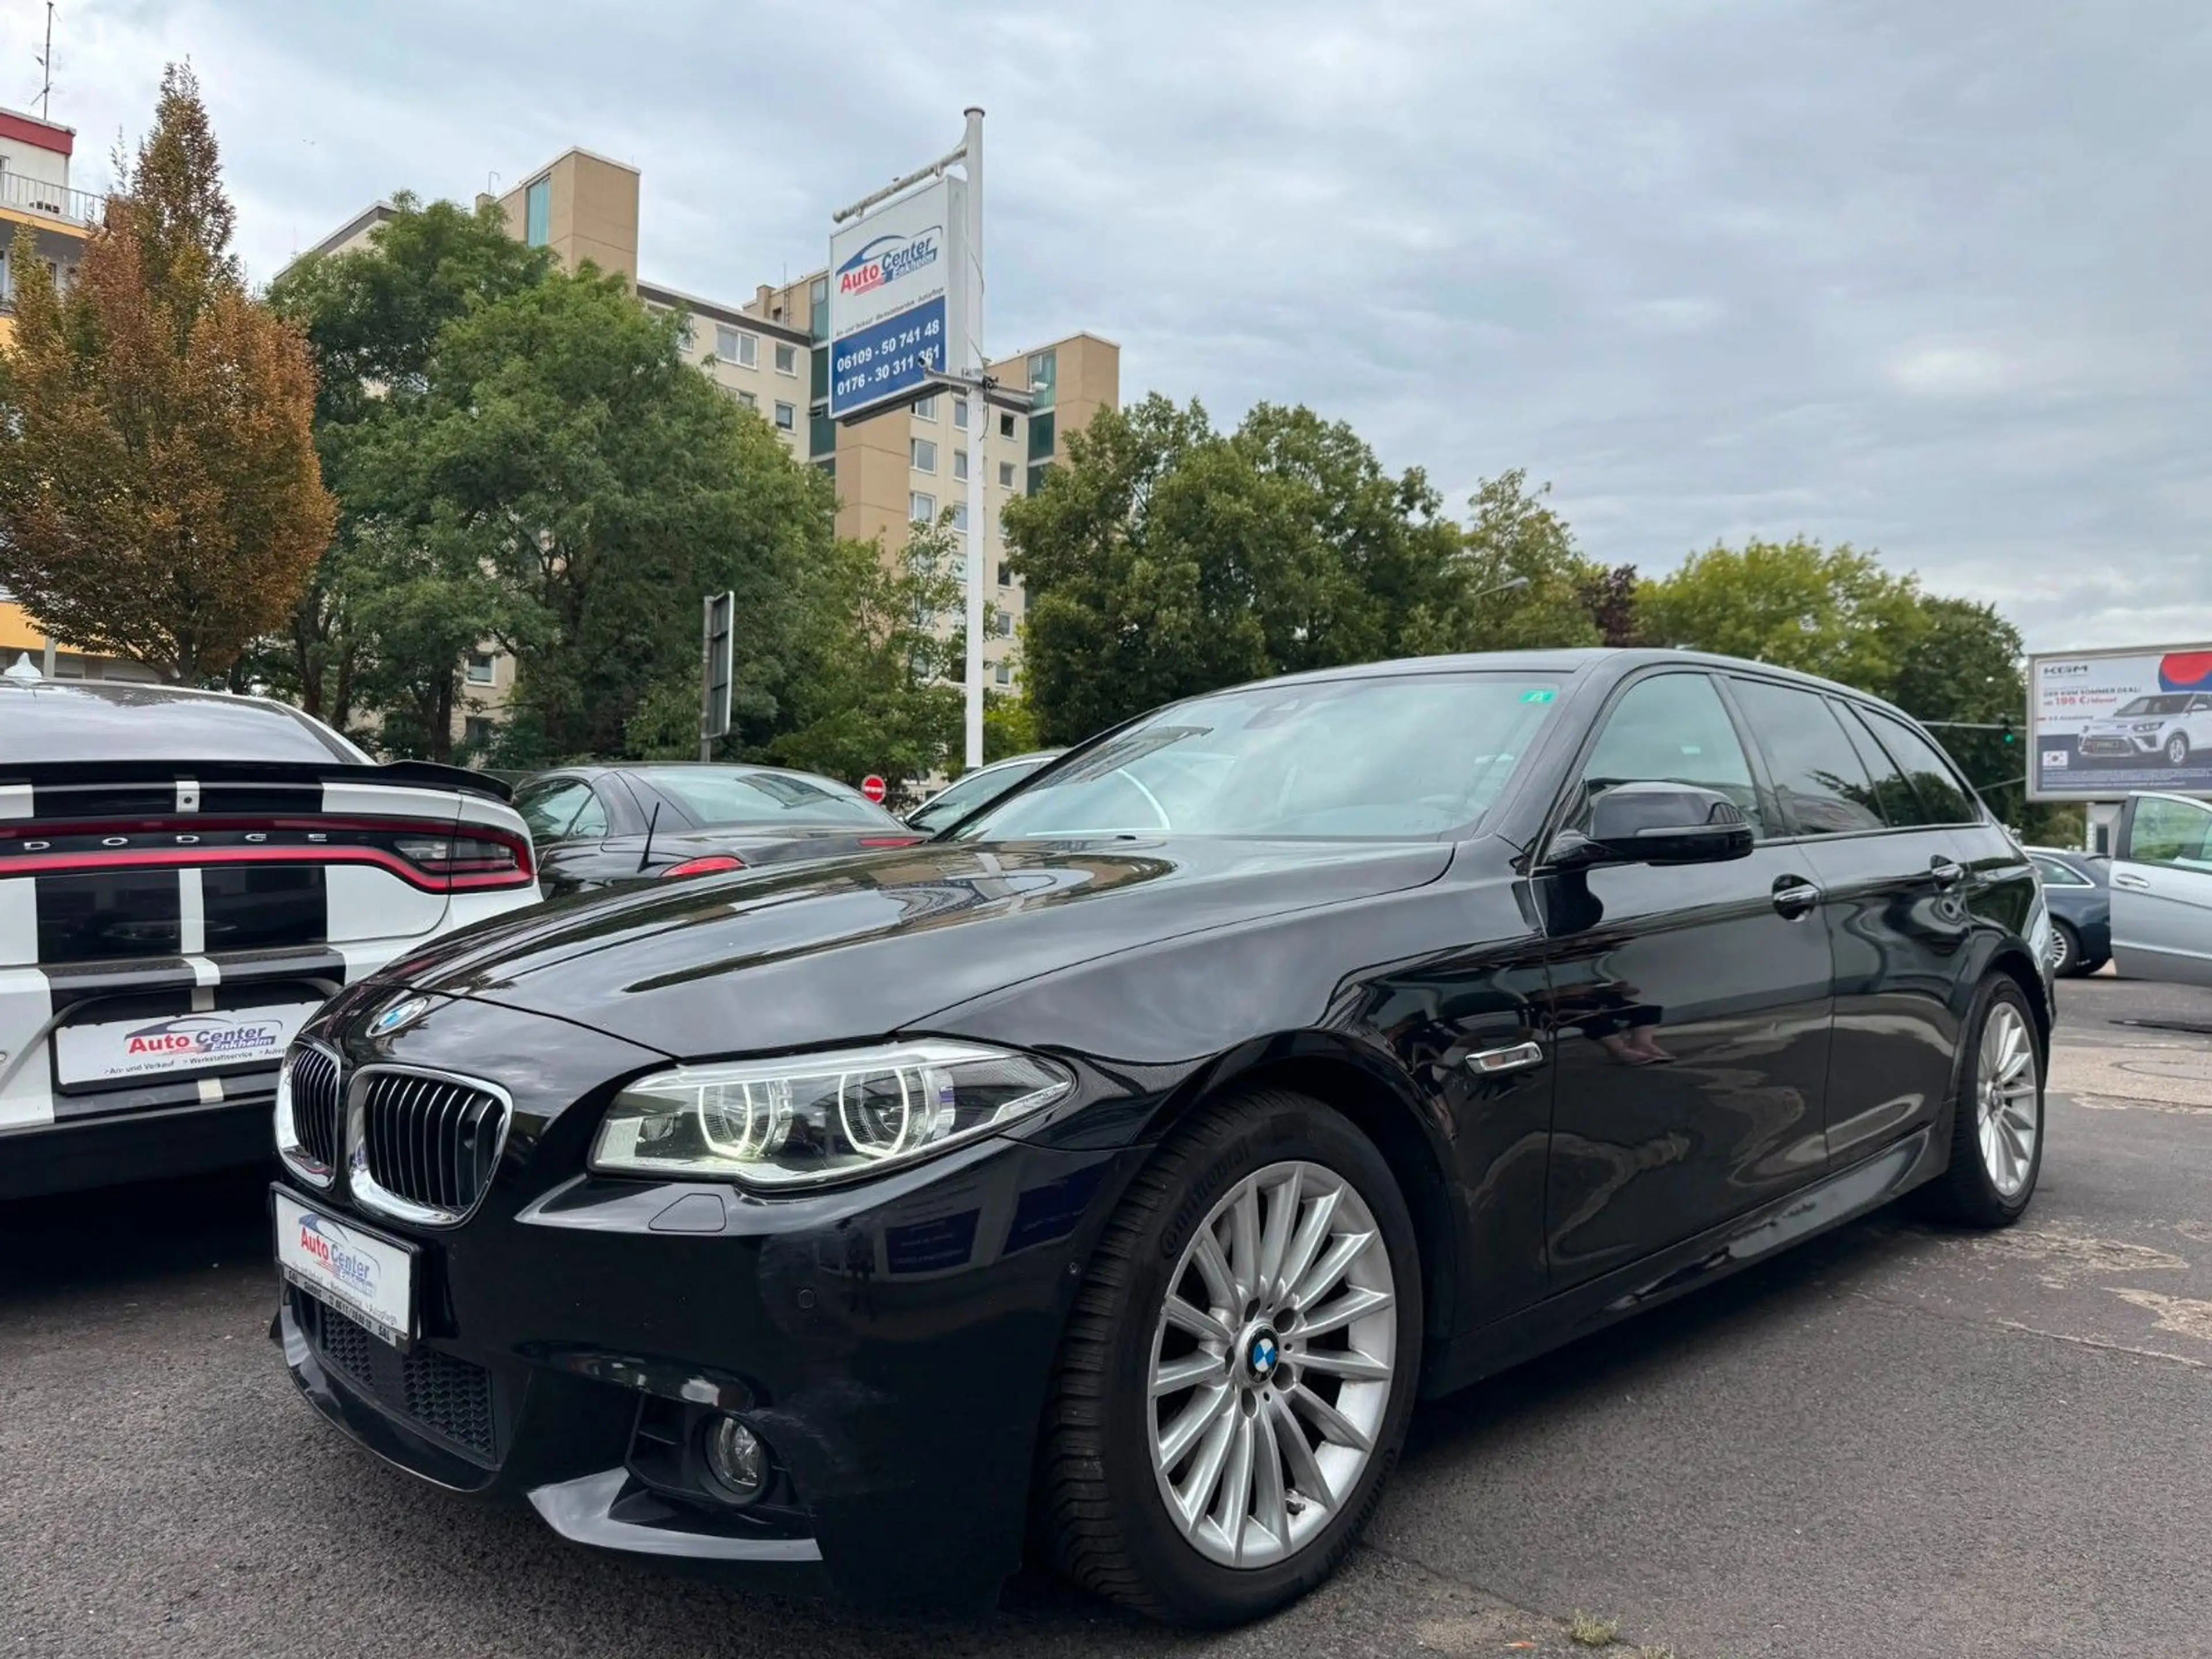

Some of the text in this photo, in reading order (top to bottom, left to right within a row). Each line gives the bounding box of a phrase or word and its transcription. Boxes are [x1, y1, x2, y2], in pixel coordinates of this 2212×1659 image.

[840, 263, 880, 294] Auto
[882, 237, 932, 272] Center
[837, 347, 872, 372] 06109
[881, 337, 896, 355] 50
[899, 325, 921, 348] 741
[924, 319, 940, 337] 48
[837, 373, 865, 396] 0176
[874, 363, 890, 382] 30
[892, 354, 914, 375] 311
[24, 833, 328, 851] DODGE
[128, 1026, 266, 1054] Auto Center
[300, 1226, 329, 1262] Auto
[331, 1243, 370, 1281] Center
